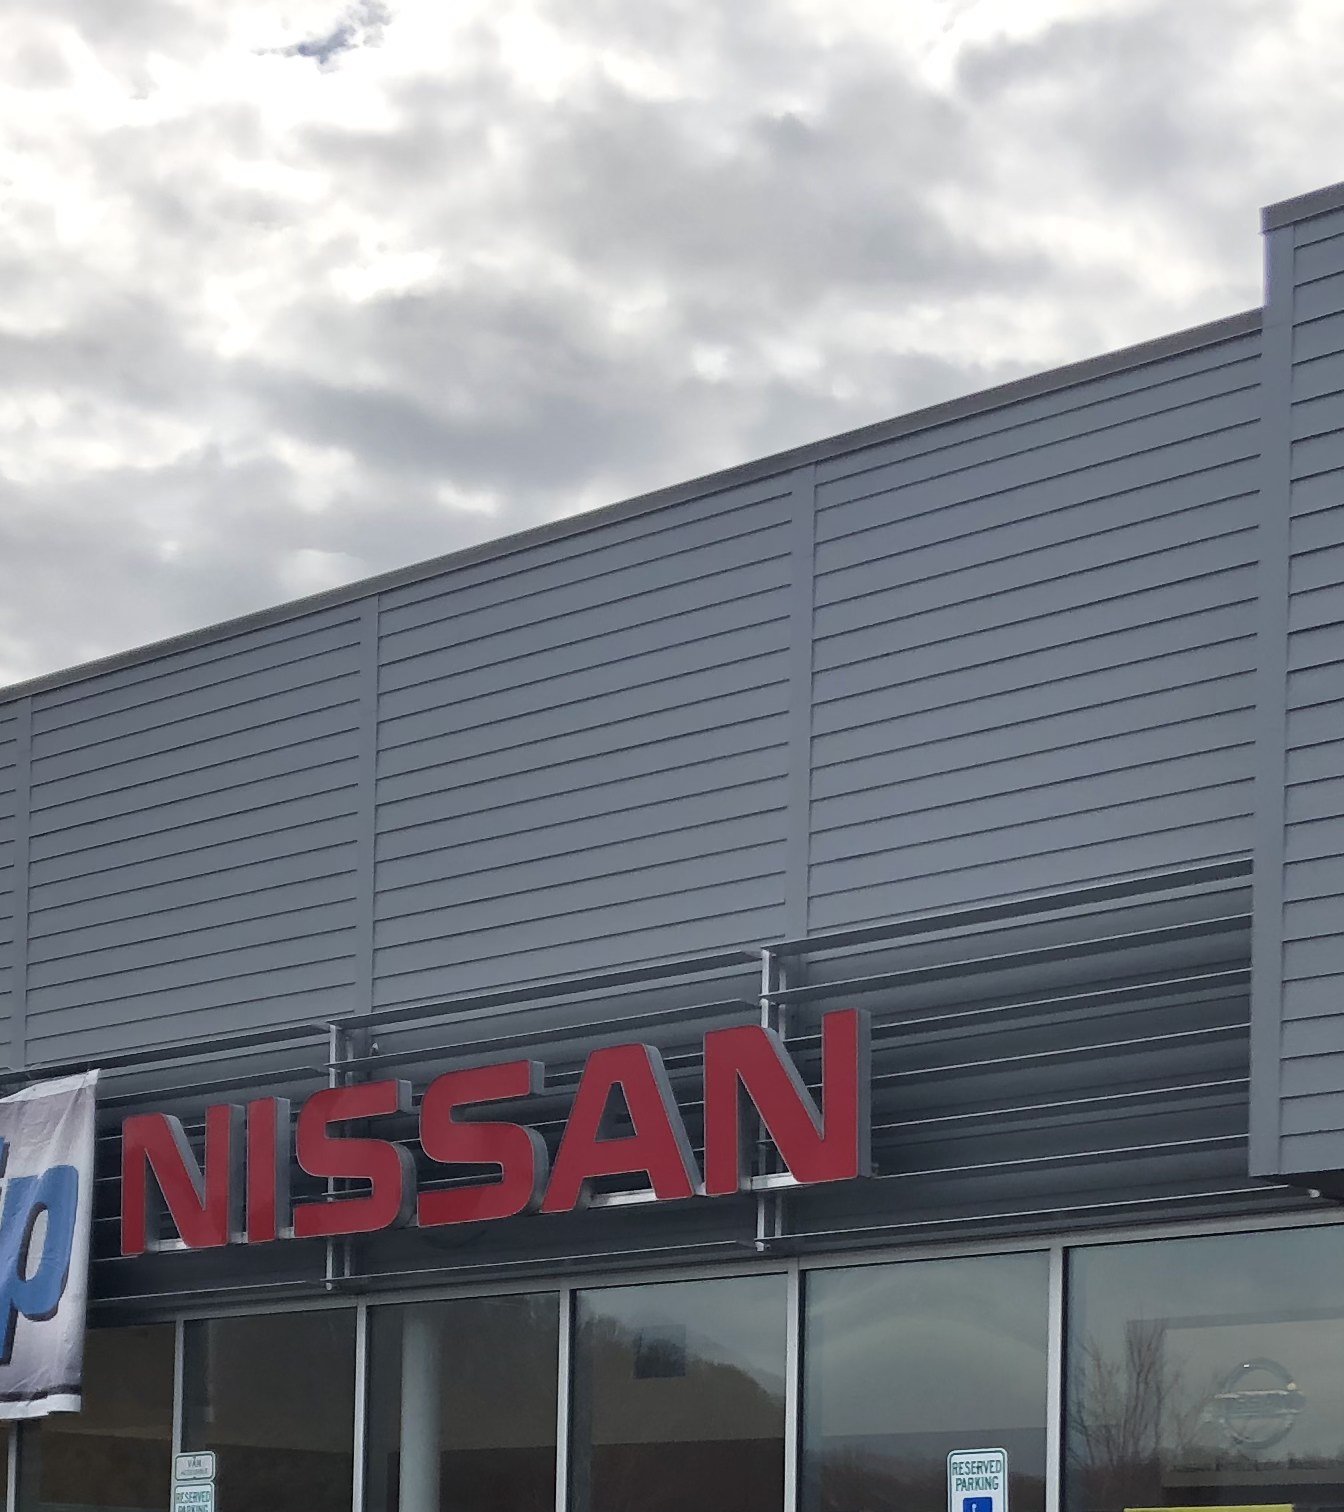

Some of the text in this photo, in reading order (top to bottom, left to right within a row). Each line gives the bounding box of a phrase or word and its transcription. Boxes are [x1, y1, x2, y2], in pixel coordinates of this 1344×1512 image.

[121, 1008, 872, 1256] NISSAN
[952, 1459, 1002, 1476] RESERVED
[955, 1476, 999, 1492] PARKING
[176, 1491, 211, 1504] RESERVED
